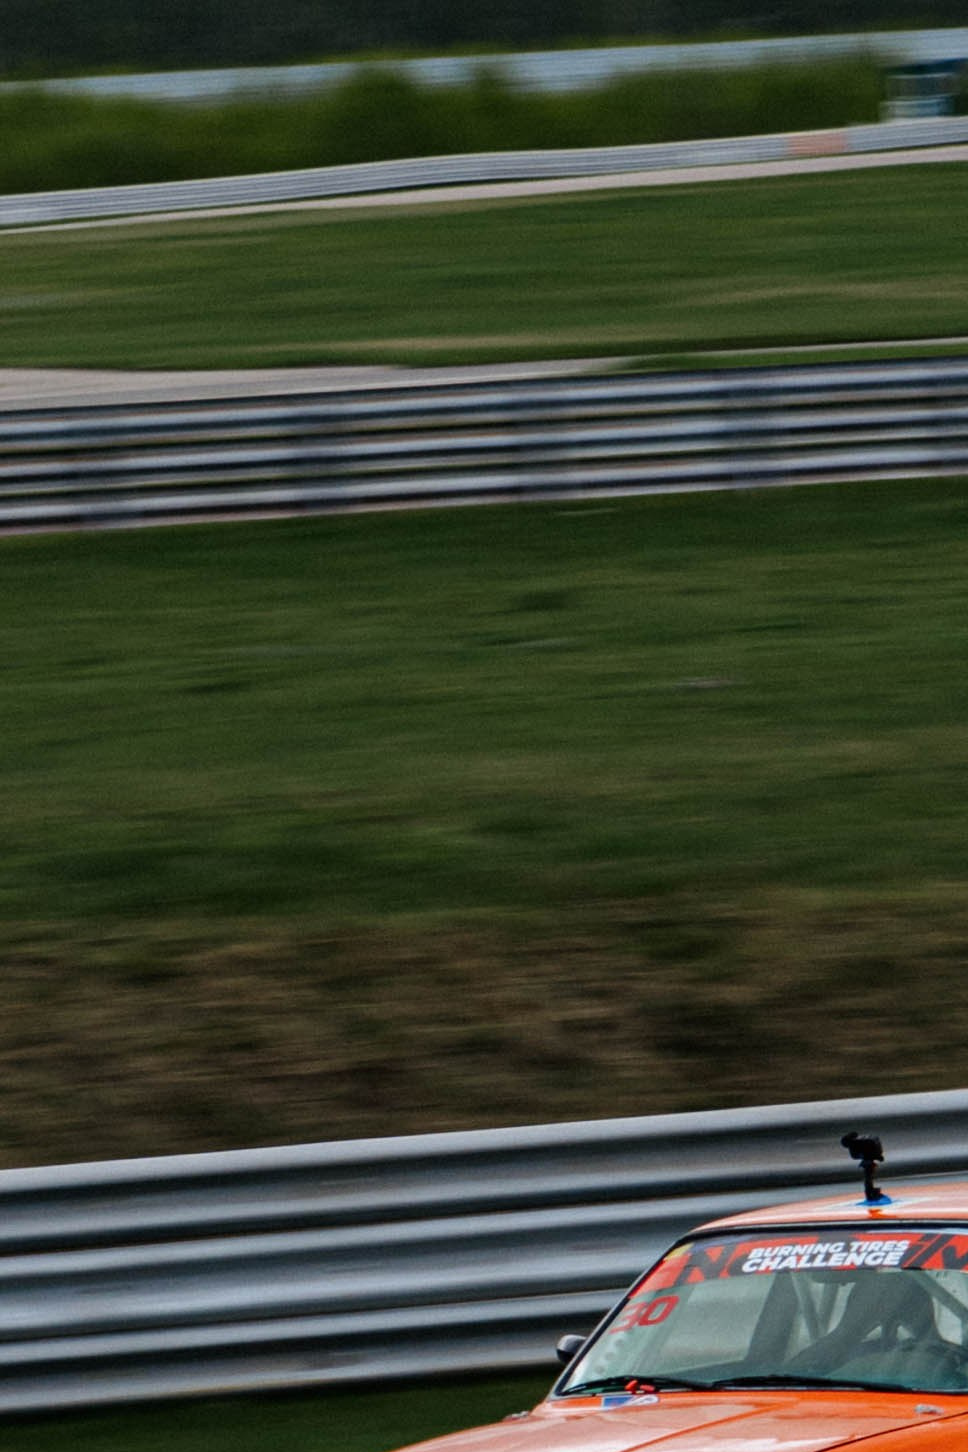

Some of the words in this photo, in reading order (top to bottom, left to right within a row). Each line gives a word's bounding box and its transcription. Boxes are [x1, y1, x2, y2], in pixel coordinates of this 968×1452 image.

[748, 1242, 845, 1259] BURNING
[850, 1240, 911, 1254] TIRES
[742, 1251, 904, 1272] CHALLENGE
